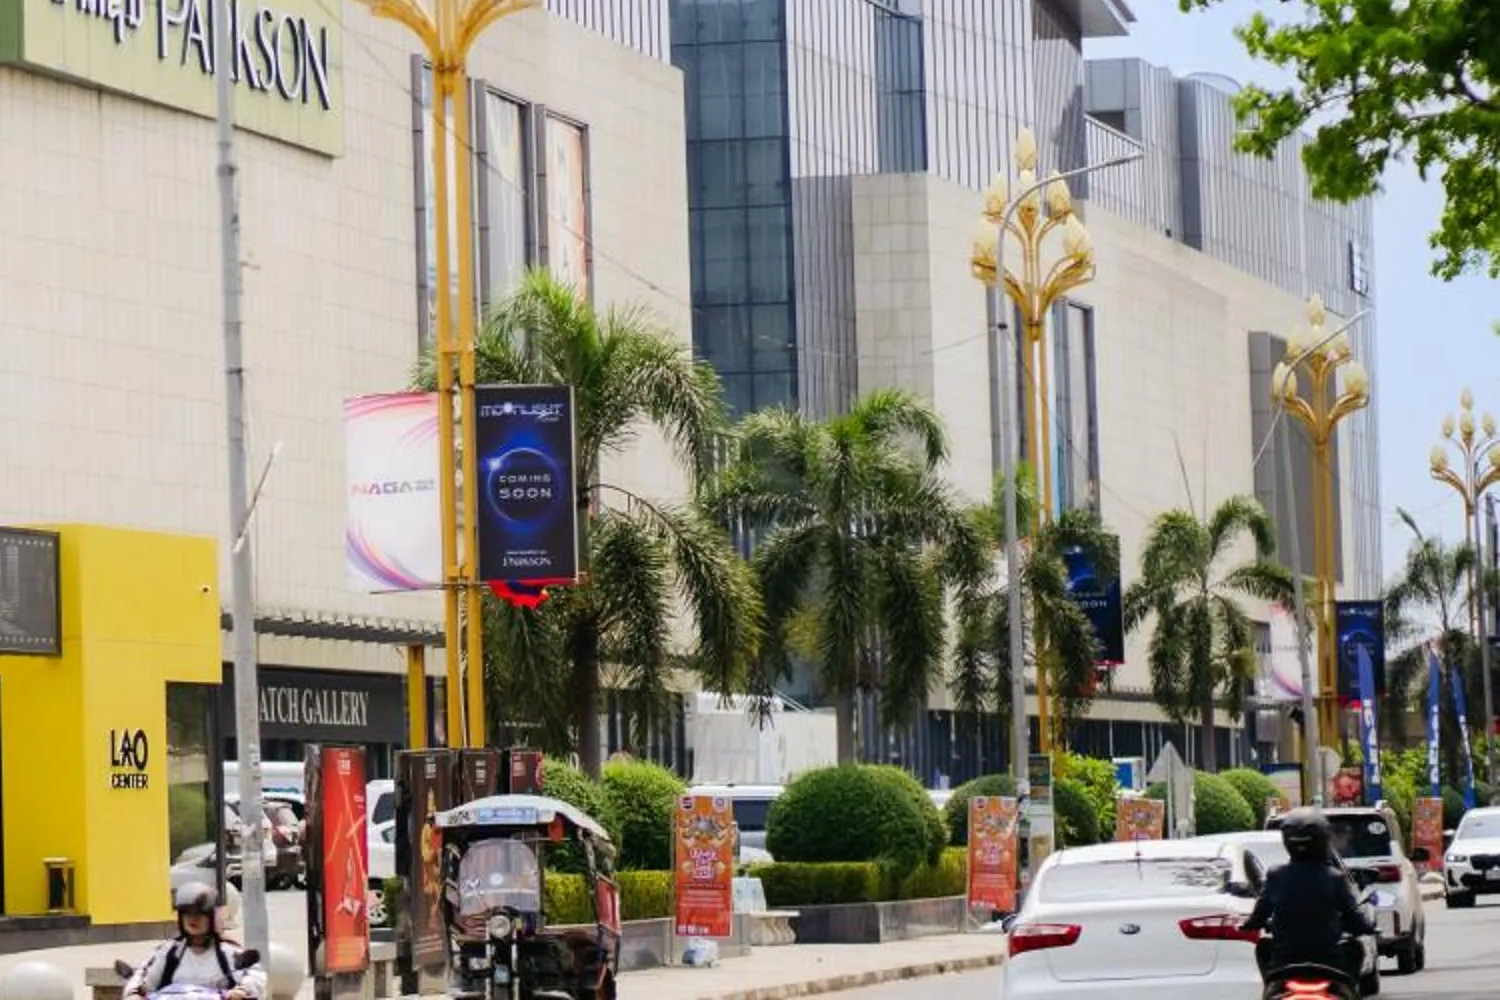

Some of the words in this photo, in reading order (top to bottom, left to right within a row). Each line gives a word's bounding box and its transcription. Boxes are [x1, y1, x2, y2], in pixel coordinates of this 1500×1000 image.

[499, 473, 551, 484] COMING
[499, 487, 552, 500] SOON
[257, 685, 300, 724] ATCH
[301, 687, 370, 727] GALLERY
[110, 728, 149, 771] LAO
[111, 773, 149, 789] CENTER
